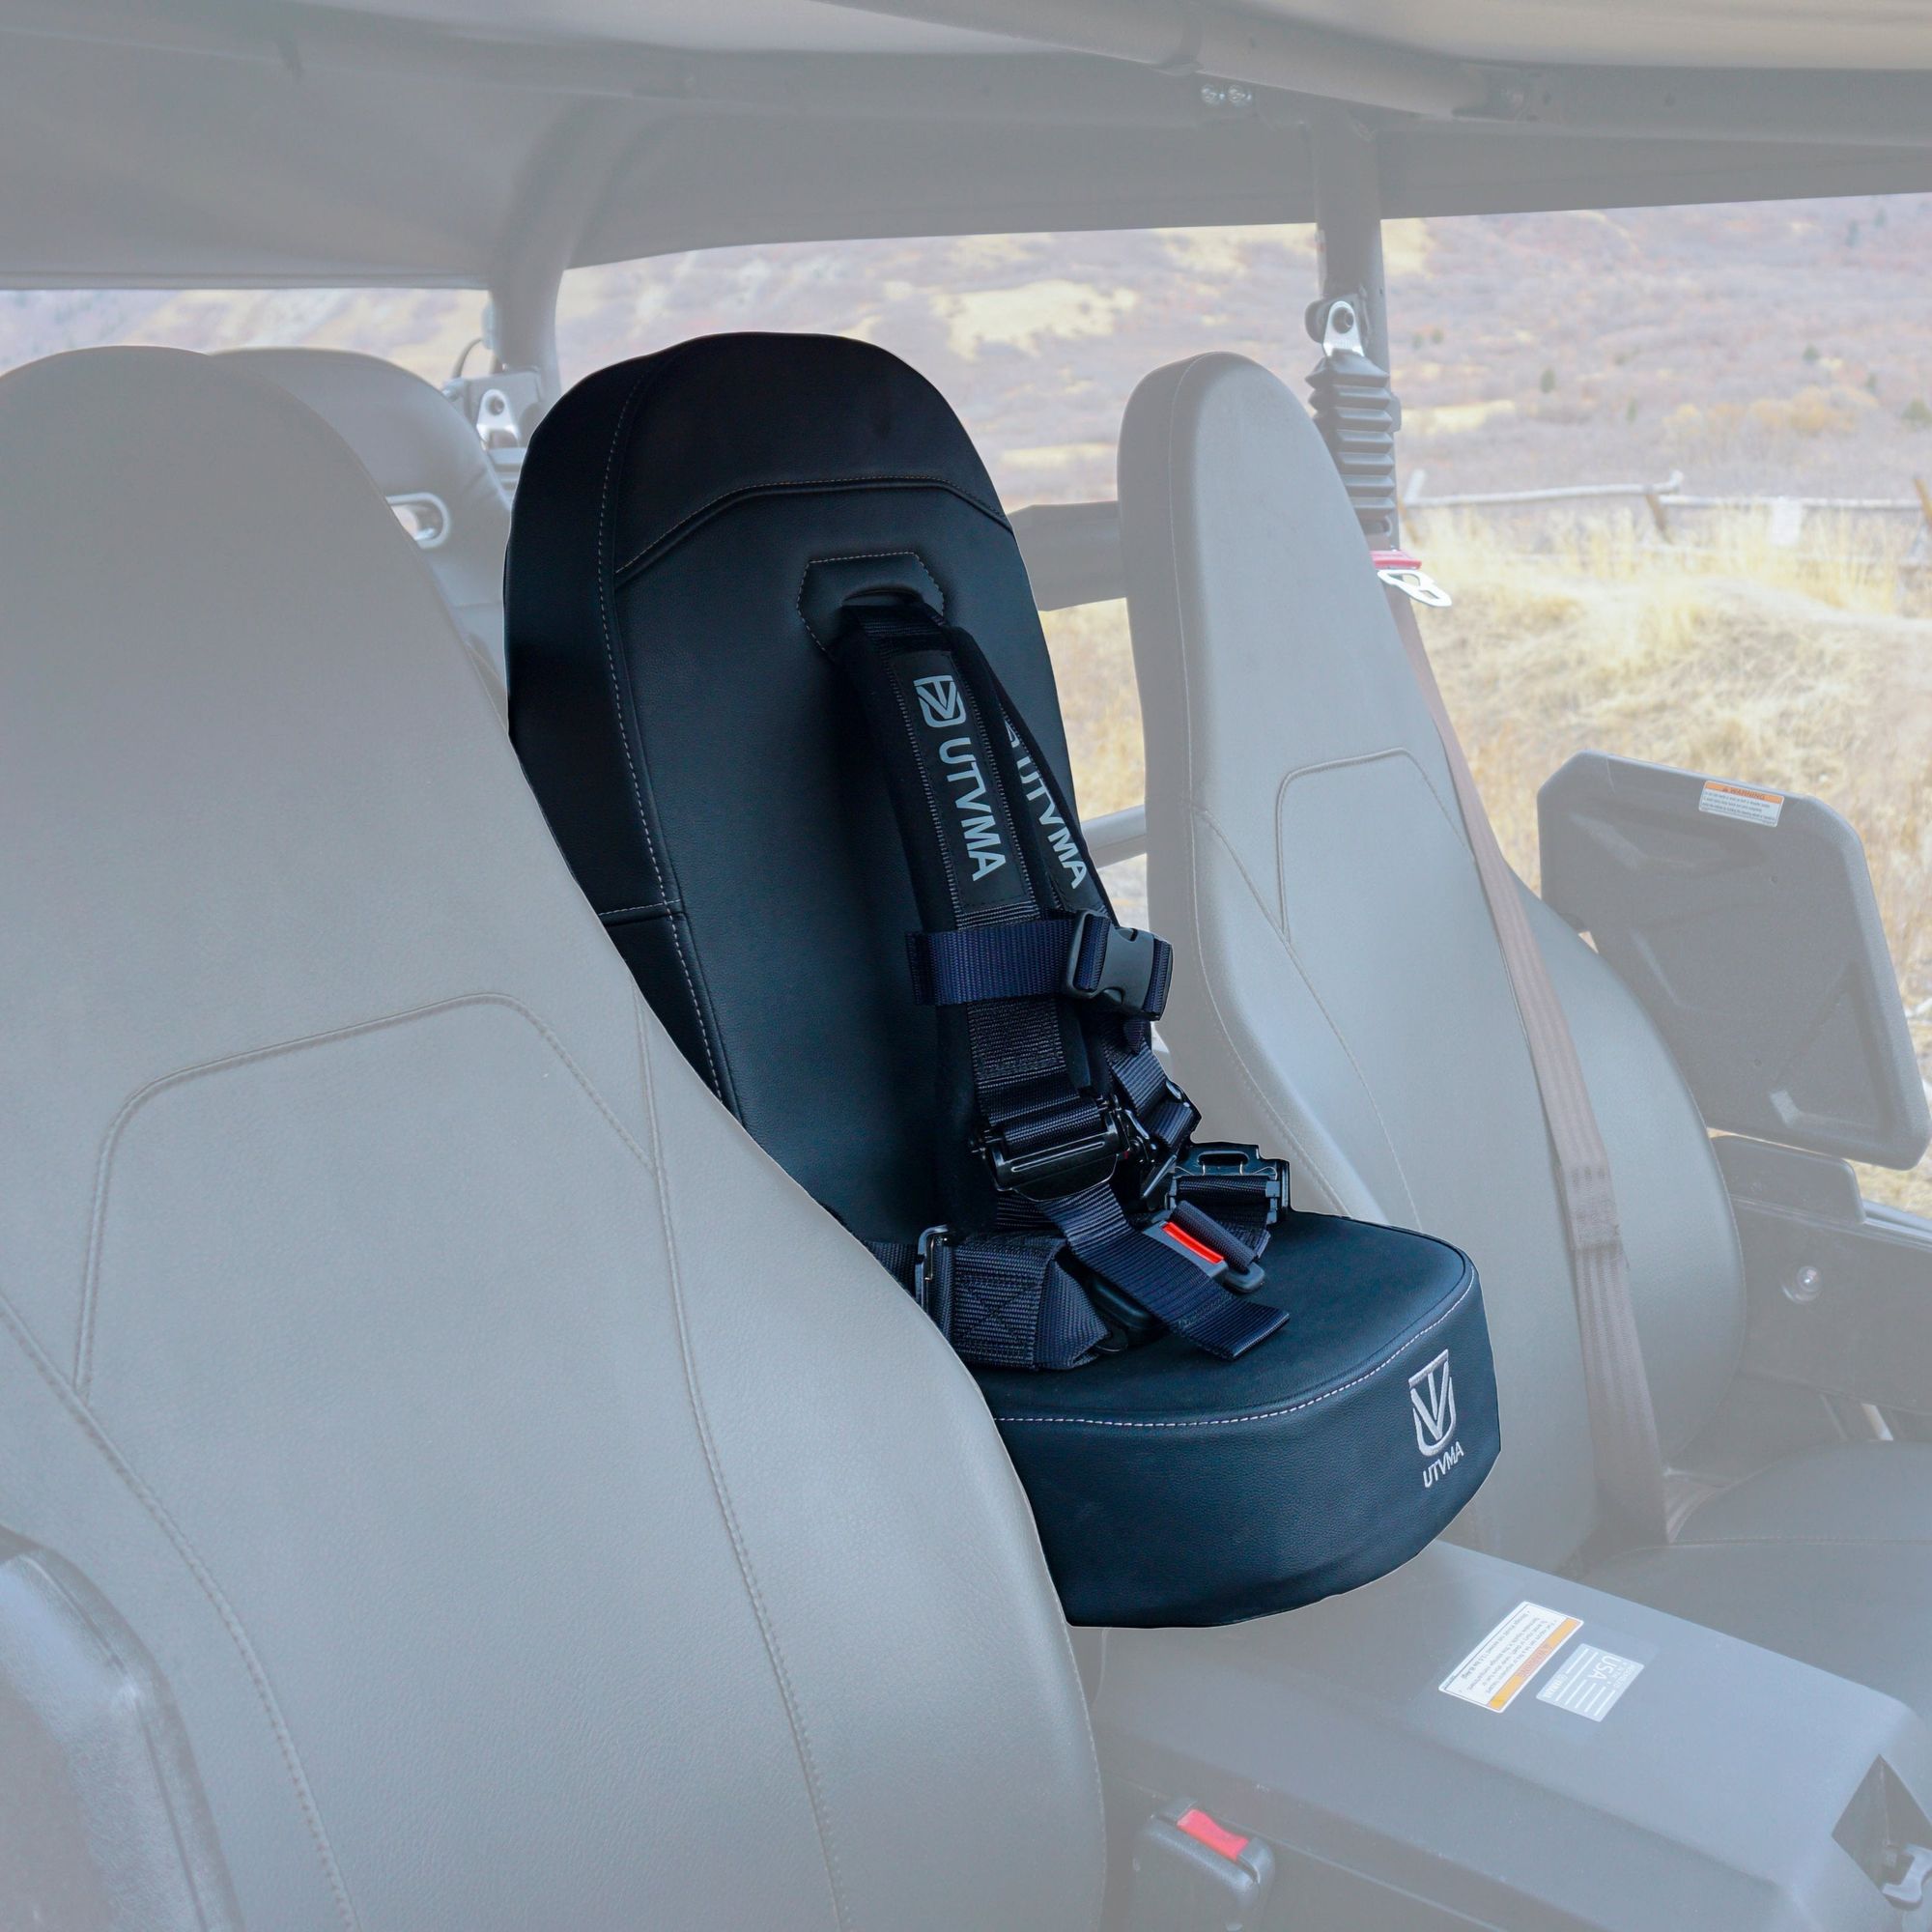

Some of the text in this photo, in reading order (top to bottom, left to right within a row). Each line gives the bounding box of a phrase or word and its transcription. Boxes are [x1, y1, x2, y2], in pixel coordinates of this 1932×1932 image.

[939, 737, 1006, 882] UTVMA
[1423, 1440, 1464, 1488] UTVMA
[1588, 1655, 1621, 1681] USA
